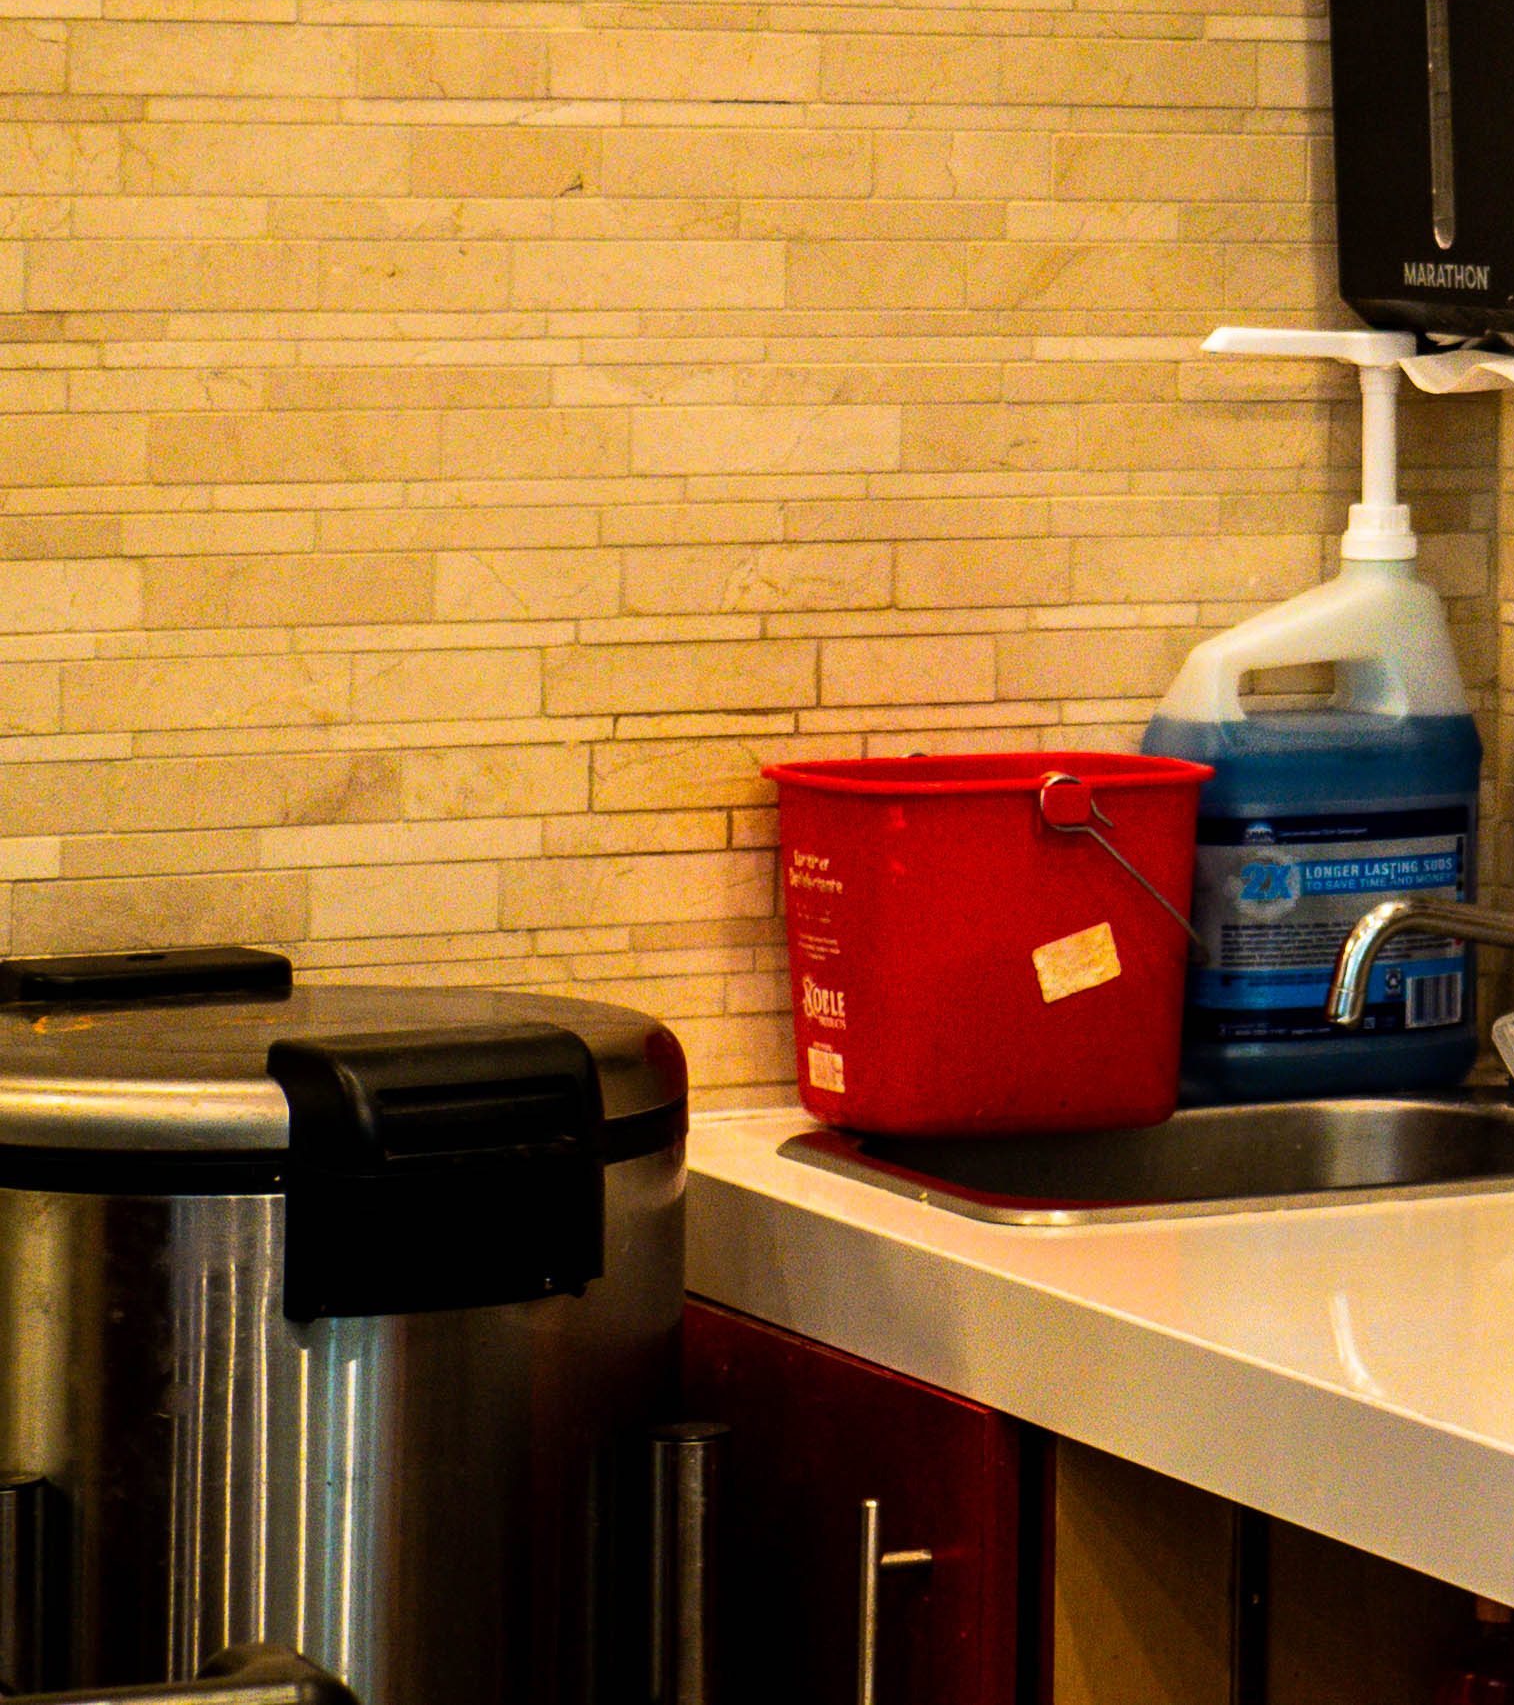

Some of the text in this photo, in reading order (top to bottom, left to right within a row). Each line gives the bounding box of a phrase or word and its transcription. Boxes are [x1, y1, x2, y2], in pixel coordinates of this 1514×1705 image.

[1404, 262, 1489, 291] MARATHON
[1240, 861, 1292, 901] 2X
[1305, 857, 1453, 880] LONGER LASTING SUDS
[1305, 881, 1322, 891] TO
[1325, 878, 1356, 890] SAVE
[1359, 877, 1387, 888] TIME
[1388, 875, 1413, 887] AND
